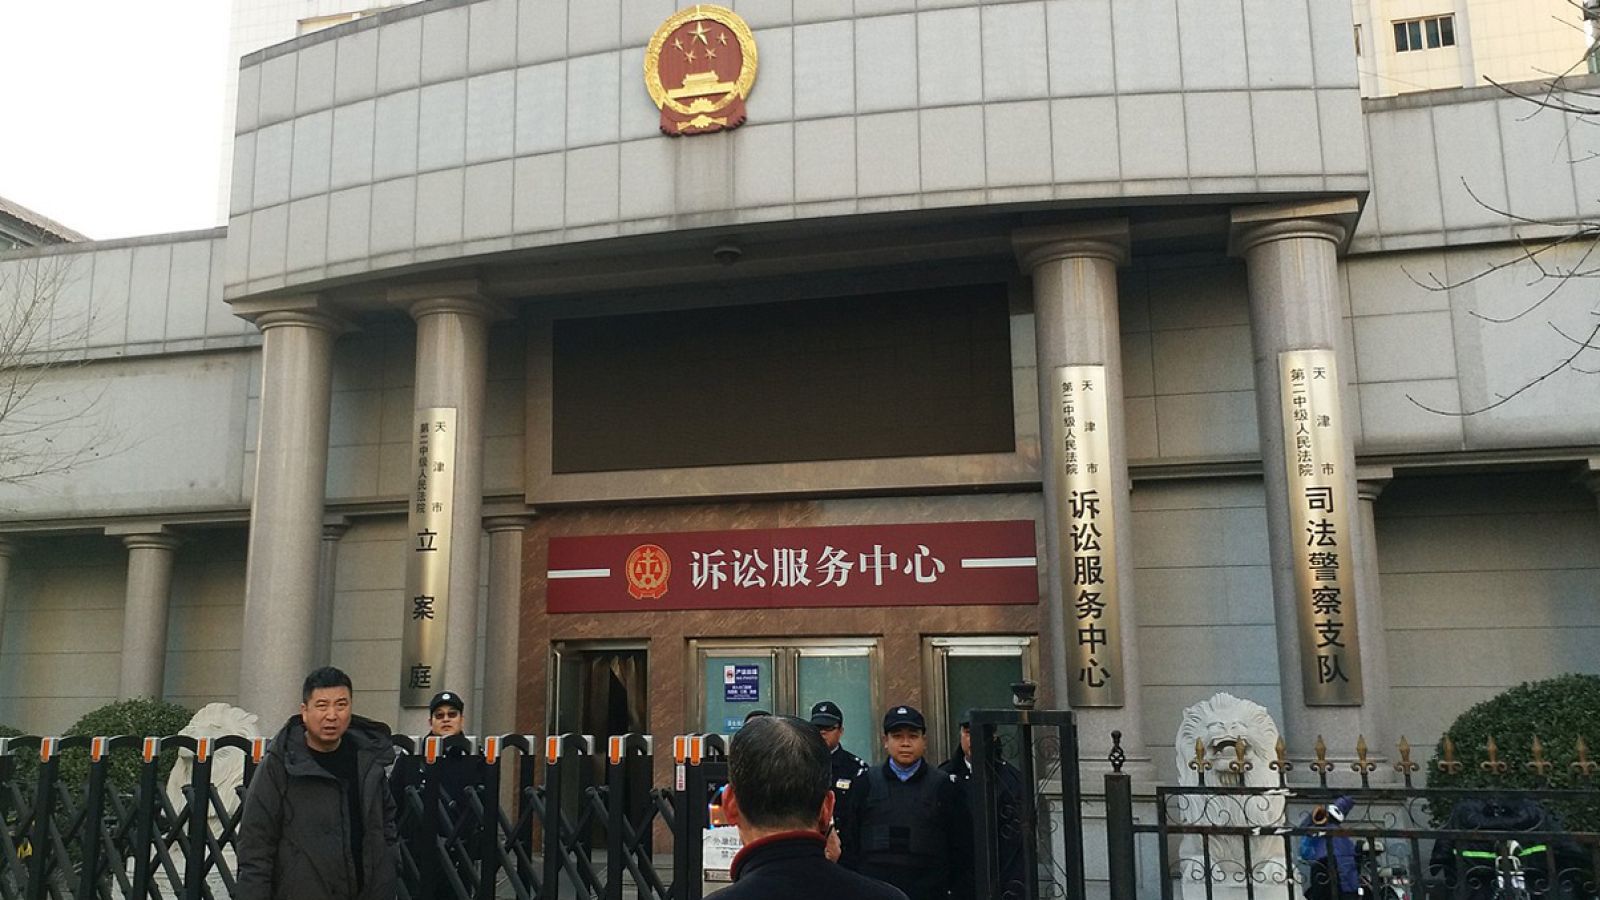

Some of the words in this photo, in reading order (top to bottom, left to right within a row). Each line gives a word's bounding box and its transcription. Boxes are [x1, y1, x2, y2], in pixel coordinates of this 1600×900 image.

[415, 423, 429, 513] 第二中级人民法院
[431, 421, 446, 513] 天津市
[1062, 382, 1078, 475] 第二中级人民法院
[1082, 380, 1098, 474] 天津市
[1290, 368, 1313, 477] 第二中级人民法院
[1313, 367, 1334, 475] 天津市
[408, 528, 437, 689] 立案庭
[688, 543, 945, 590] 诉讼服务中心
[1068, 490, 1111, 688] 诉讼服务中心
[1305, 486, 1349, 684] 司法警察支队
